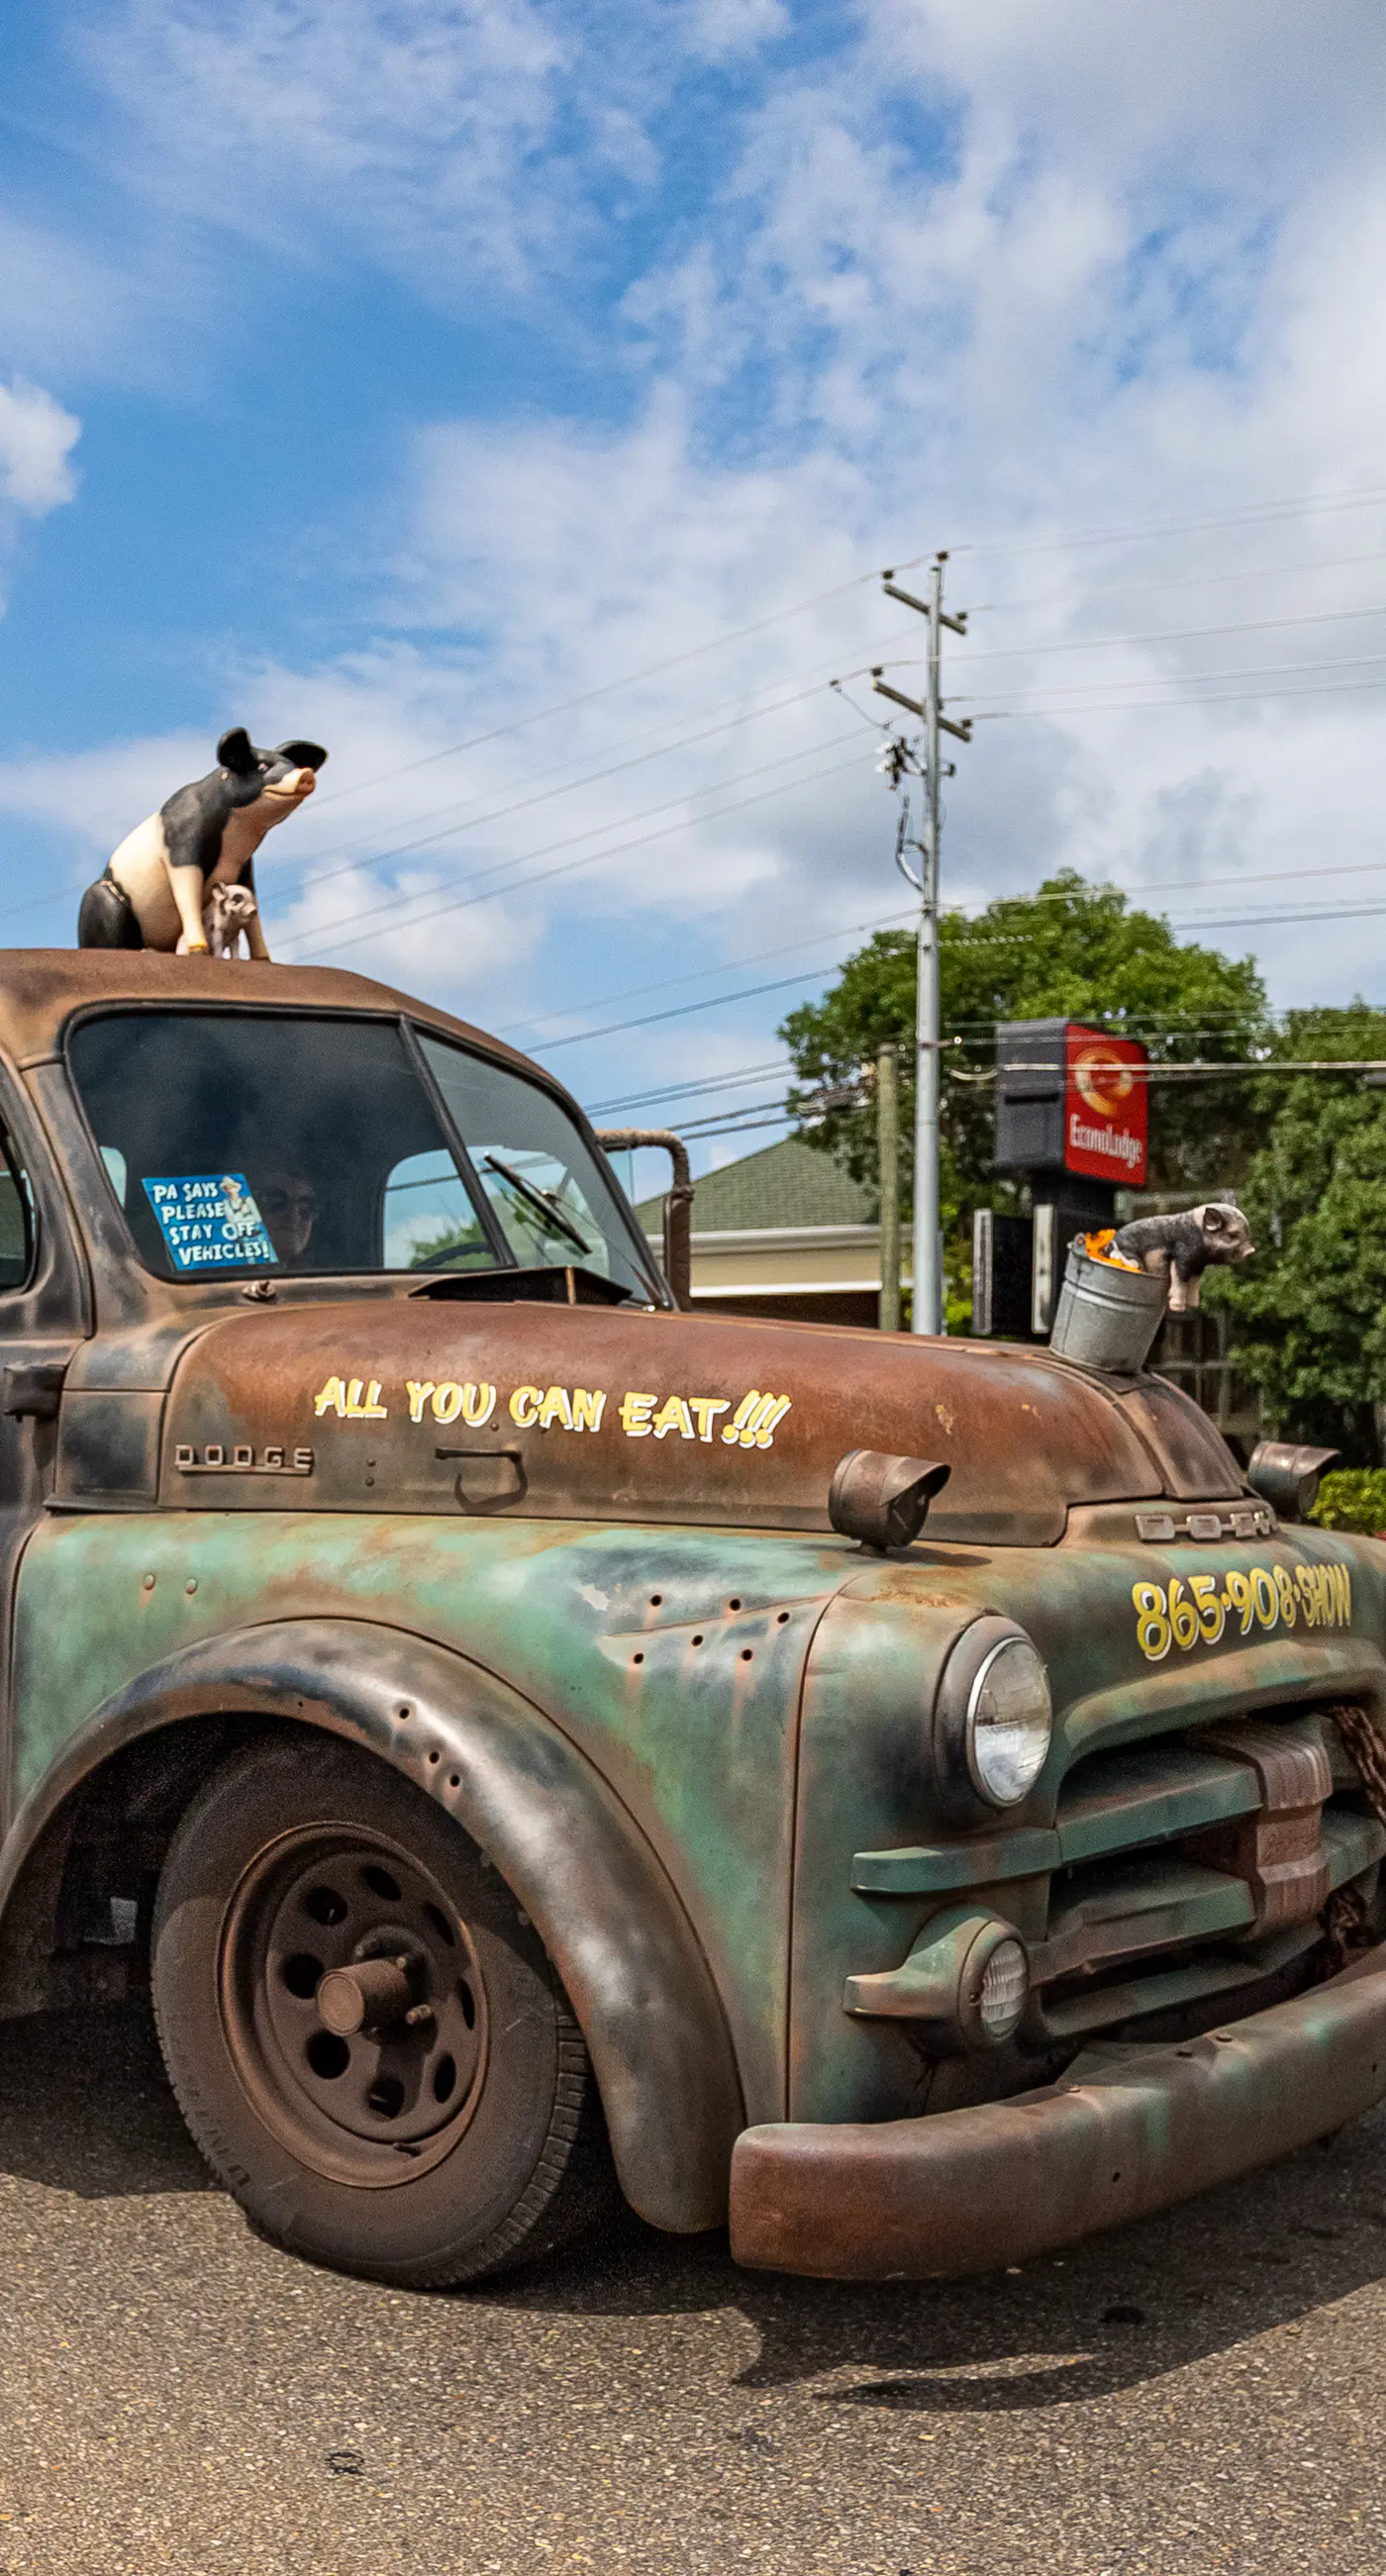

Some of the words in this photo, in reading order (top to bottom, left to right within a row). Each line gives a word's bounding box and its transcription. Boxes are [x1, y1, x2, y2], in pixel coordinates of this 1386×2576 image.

[152, 1184, 178, 1205] PA
[182, 1182, 219, 1203] SAYS
[160, 1201, 226, 1225] PLEASE
[168, 1224, 214, 1246] STAY
[221, 1222, 256, 1241] OFF
[178, 1240, 271, 1266] VEHICLES!
[314, 1375, 388, 1420] ALL
[405, 1380, 497, 1429] YOU
[508, 1385, 607, 1433] CAN
[174, 1443, 314, 1469] DODGE
